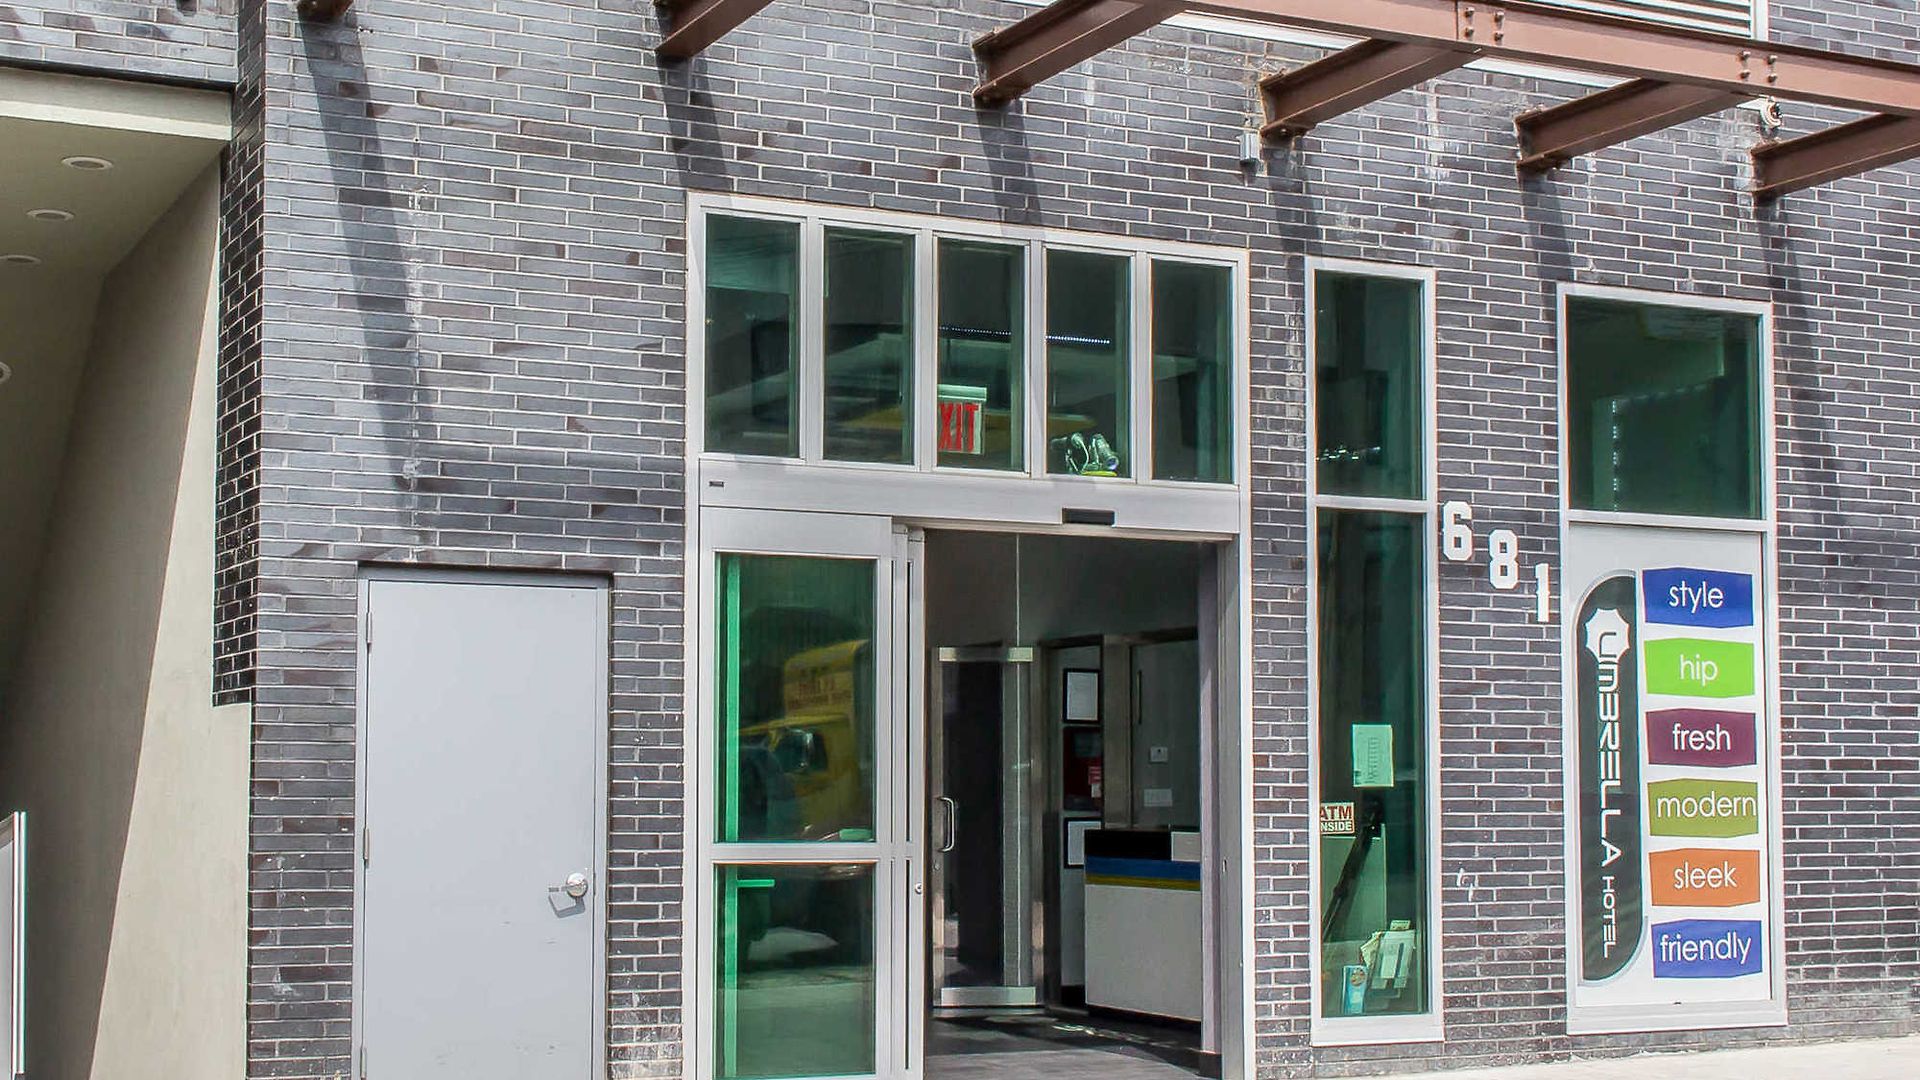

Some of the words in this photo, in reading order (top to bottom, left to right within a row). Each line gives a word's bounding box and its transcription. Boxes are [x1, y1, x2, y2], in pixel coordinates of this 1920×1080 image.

[938, 402, 979, 453] XIT
[1669, 580, 1724, 613] style
[1679, 654, 1718, 686] hip
[1672, 722, 1731, 751] fresh
[1320, 805, 1351, 819] ATM
[1656, 791, 1757, 818] modern
[1320, 821, 1352, 832] NSIDE
[1673, 862, 1737, 888] sleek
[1601, 876, 1617, 958] HOTEL
[1659, 932, 1752, 963] friendly
